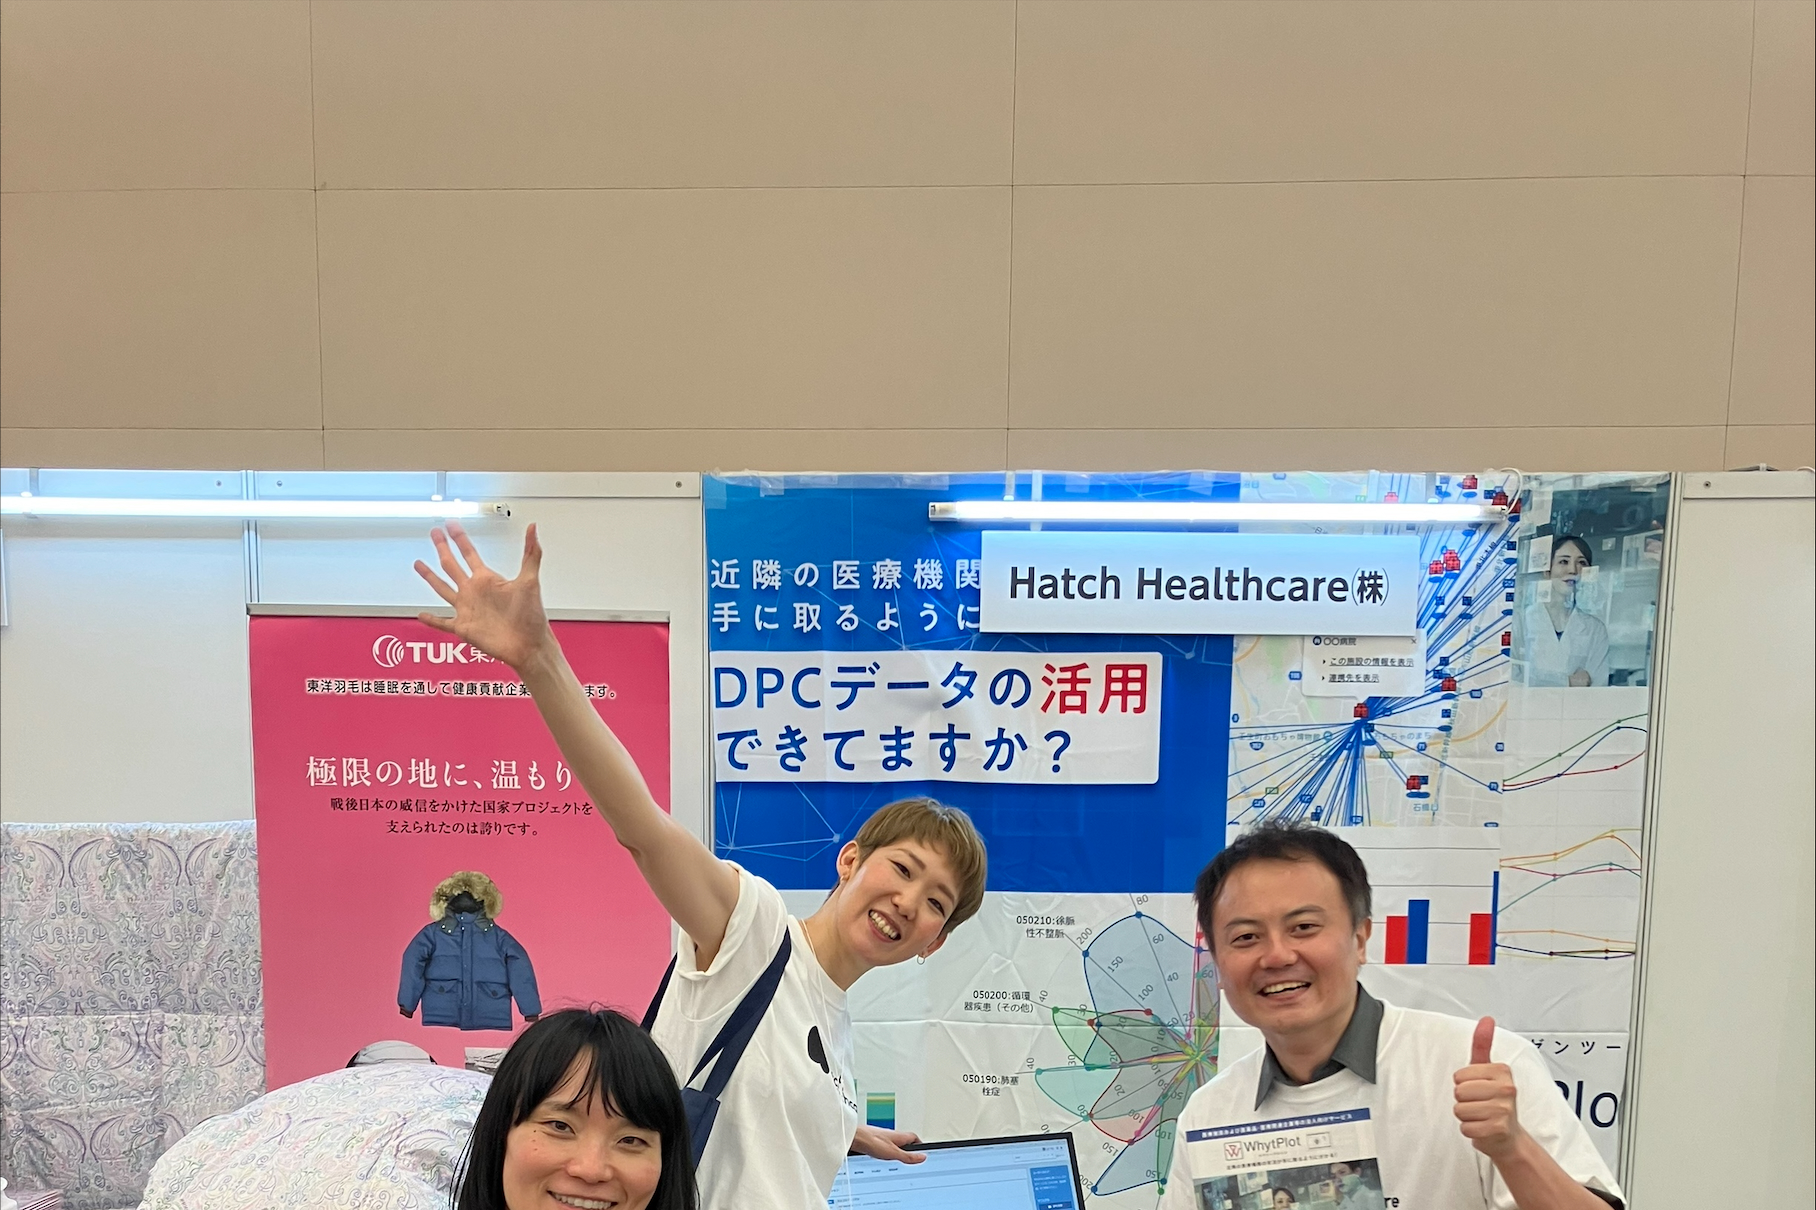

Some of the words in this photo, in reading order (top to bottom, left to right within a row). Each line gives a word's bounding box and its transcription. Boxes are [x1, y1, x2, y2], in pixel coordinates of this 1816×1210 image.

[710, 558, 982, 591] 近隣の医療機関
[1008, 566, 1121, 600] Hatch
[711, 601, 981, 633] 手に取るように
[1330, 657, 1415, 667] この施設の情報を表示
[1328, 673, 1380, 683] 連携先を表示
[714, 660, 1149, 716] DPCデータの活用
[716, 725, 1072, 773] できてますか？
[305, 756, 573, 792] 極限の地に、温もり
[330, 797, 594, 815] 戦後日本の威信をかけた国家プロジェクトを
[385, 820, 539, 836] 支えられたのは誇りです。
[1136, 894, 1149, 906] 80
[1016, 915, 1076, 926] 050210:徐脈
[1025, 928, 1065, 939] 性不整脈
[1076, 927, 1093, 945] 200
[1152, 933, 1165, 945] 60
[1107, 956, 1124, 973] 150
[1167, 972, 1179, 983] 40
[972, 990, 1032, 1001] 050200:循環
[1038, 990, 1049, 1003] 40
[1138, 984, 1154, 1002] 100
[1026, 1057, 1035, 1069] 40
[1068, 1054, 1077, 1066] 30
[962, 1074, 1020, 1085] 050190:肺塞
[982, 1086, 1001, 1097] 栓症
[1114, 1084, 1126, 1096] 20
[1102, 1141, 1119, 1156] 150
[1244, 1136, 1301, 1153] WhytPlot
